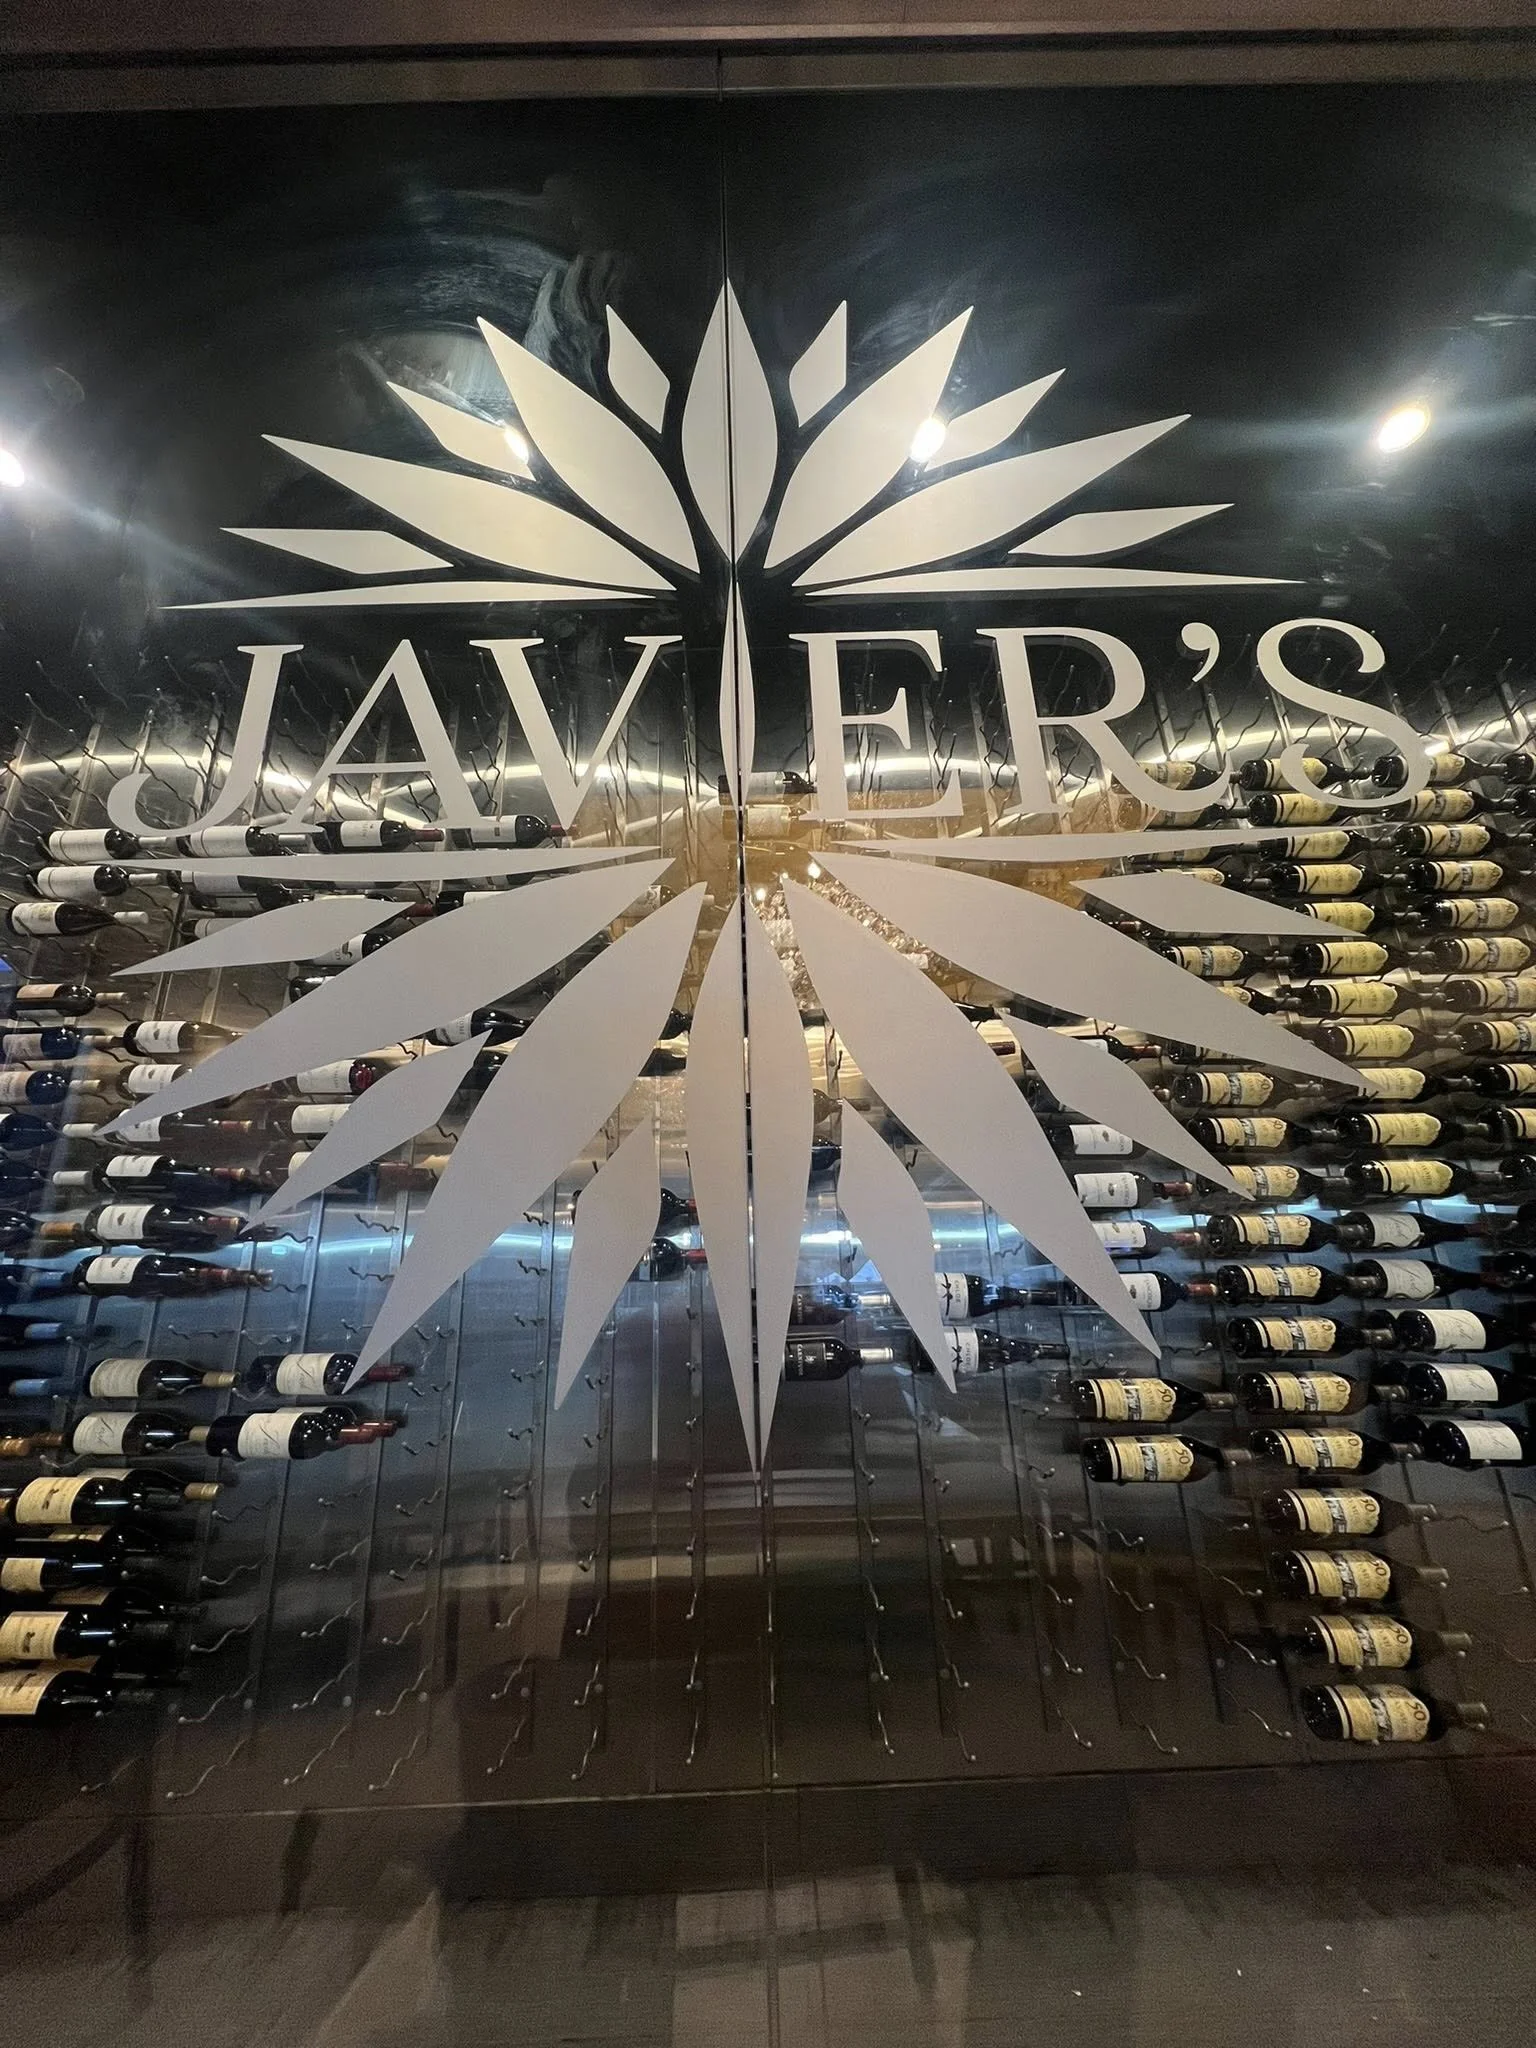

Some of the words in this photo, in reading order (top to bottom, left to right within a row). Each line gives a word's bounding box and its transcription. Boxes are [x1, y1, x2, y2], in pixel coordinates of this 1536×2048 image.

[107, 617, 1431, 838] JAVIER'S
[1158, 1386, 1174, 1403] 50
[1175, 1447, 1191, 1465] 50
[1406, 1700, 1428, 1721] 50
